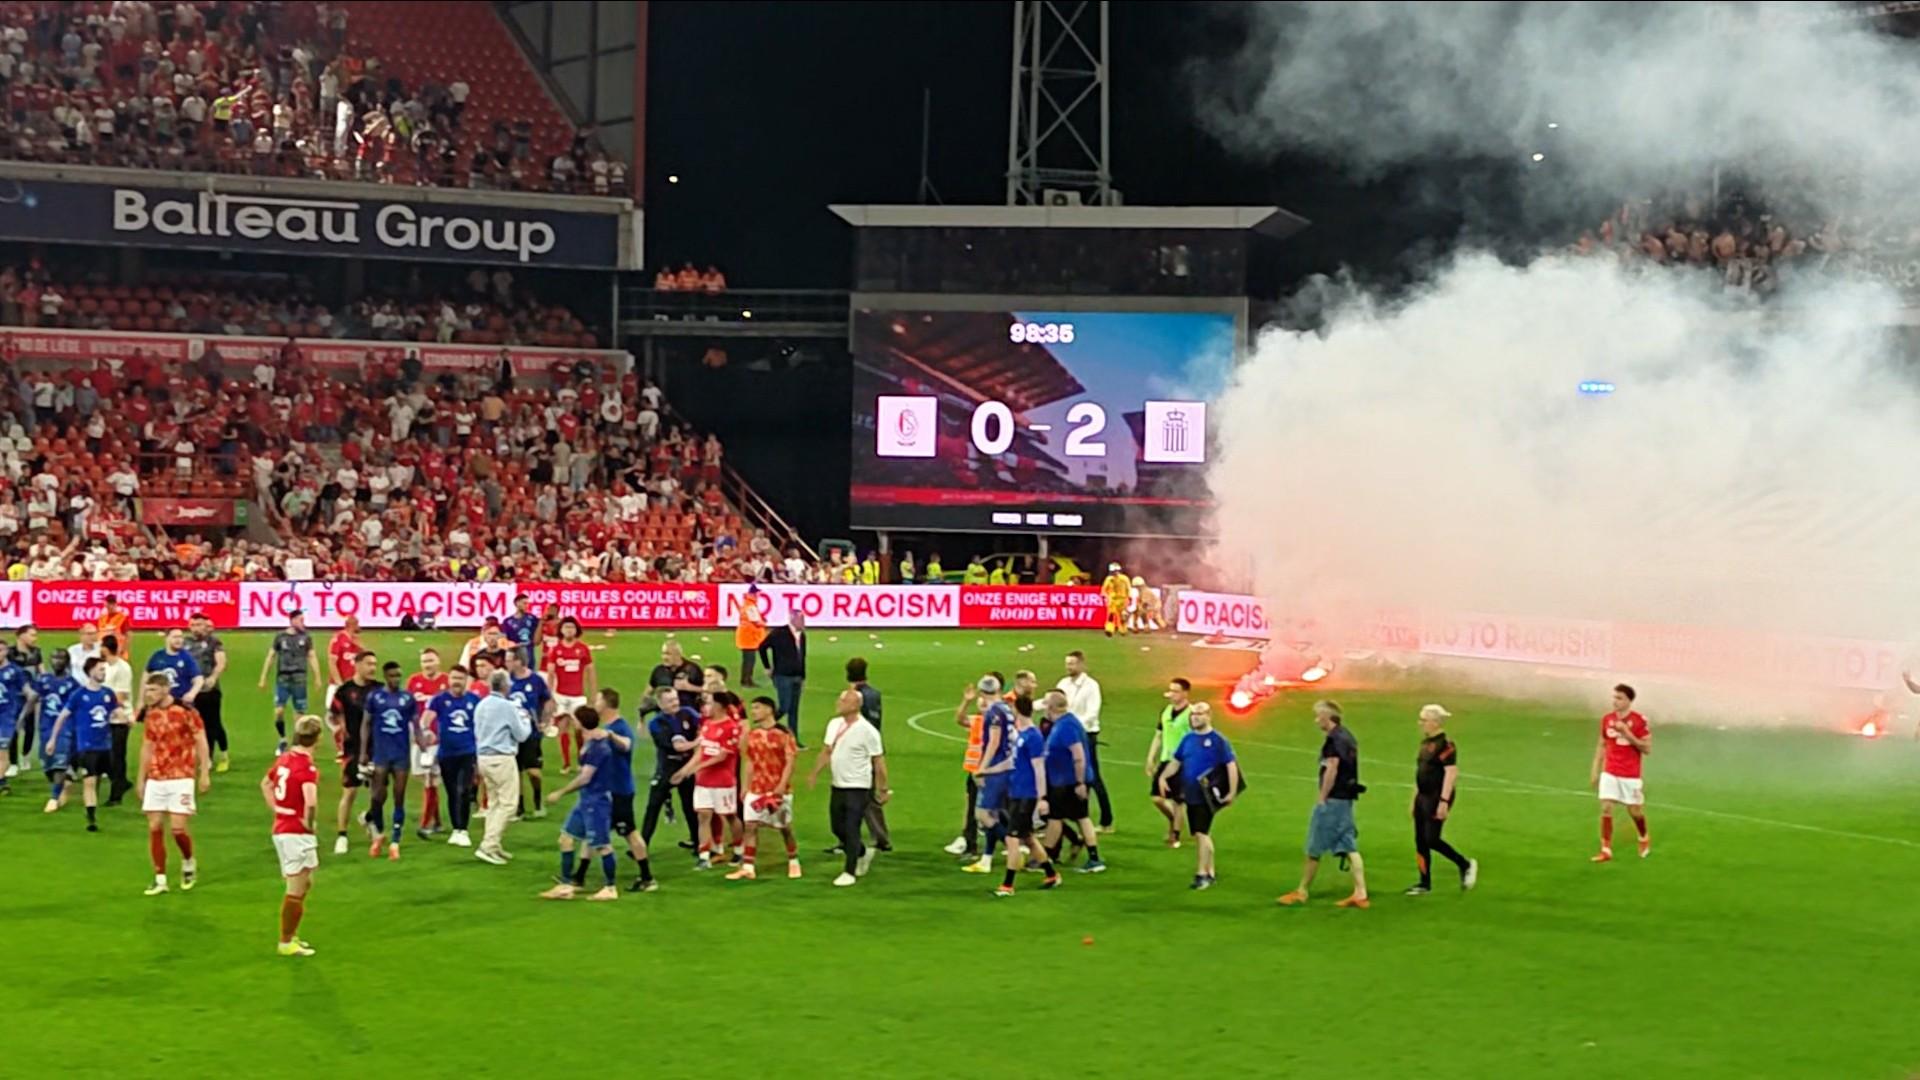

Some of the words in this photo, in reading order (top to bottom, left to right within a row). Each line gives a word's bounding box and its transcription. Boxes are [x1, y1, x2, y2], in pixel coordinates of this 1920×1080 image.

[114, 190, 360, 243] Balteau
[375, 204, 556, 262] Group
[1009, 323, 1075, 343] 98:35
[971, 401, 1015, 454] 0
[1065, 402, 1106, 456] 2
[37, 589, 88, 604] ONZE
[250, 591, 302, 617] NO
[314, 591, 360, 617] TO
[372, 591, 507, 618] RACISM
[560, 589, 620, 604] SEULES
[782, 593, 823, 617] TO
[833, 593, 952, 617] RACISM
[963, 592, 1003, 606] ONZE
[1005, 592, 1048, 606] ENIGE
[133, 606, 159, 620] EN
[608, 606, 629, 619] ET
[631, 606, 652, 619] LE
[990, 607, 1034, 620] ROOD
[1037, 607, 1057, 620] EN
[274, 765, 291, 801] 3
